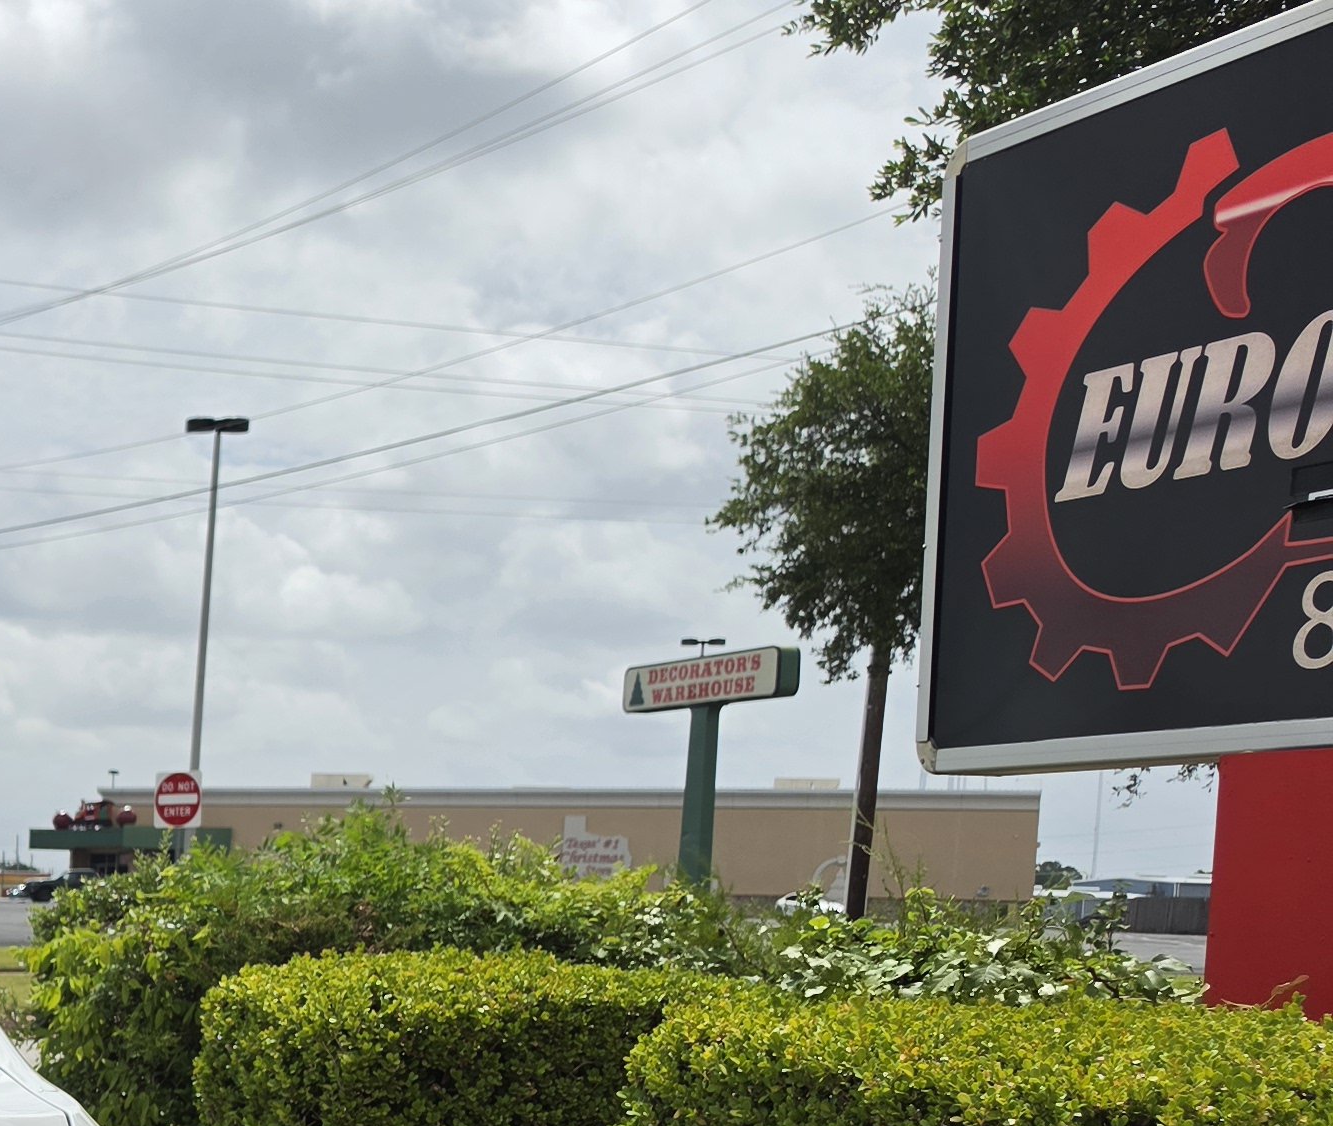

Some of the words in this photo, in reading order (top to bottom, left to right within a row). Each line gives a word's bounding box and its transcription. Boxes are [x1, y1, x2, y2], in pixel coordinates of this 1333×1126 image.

[1054, 309, 1333, 503] EURO
[647, 653, 761, 685] DECORATOR'S
[651, 675, 756, 705] WAREHOUSE
[161, 781, 174, 793] DO
[178, 780, 195, 793] NOT
[163, 806, 191, 818] ENTER
